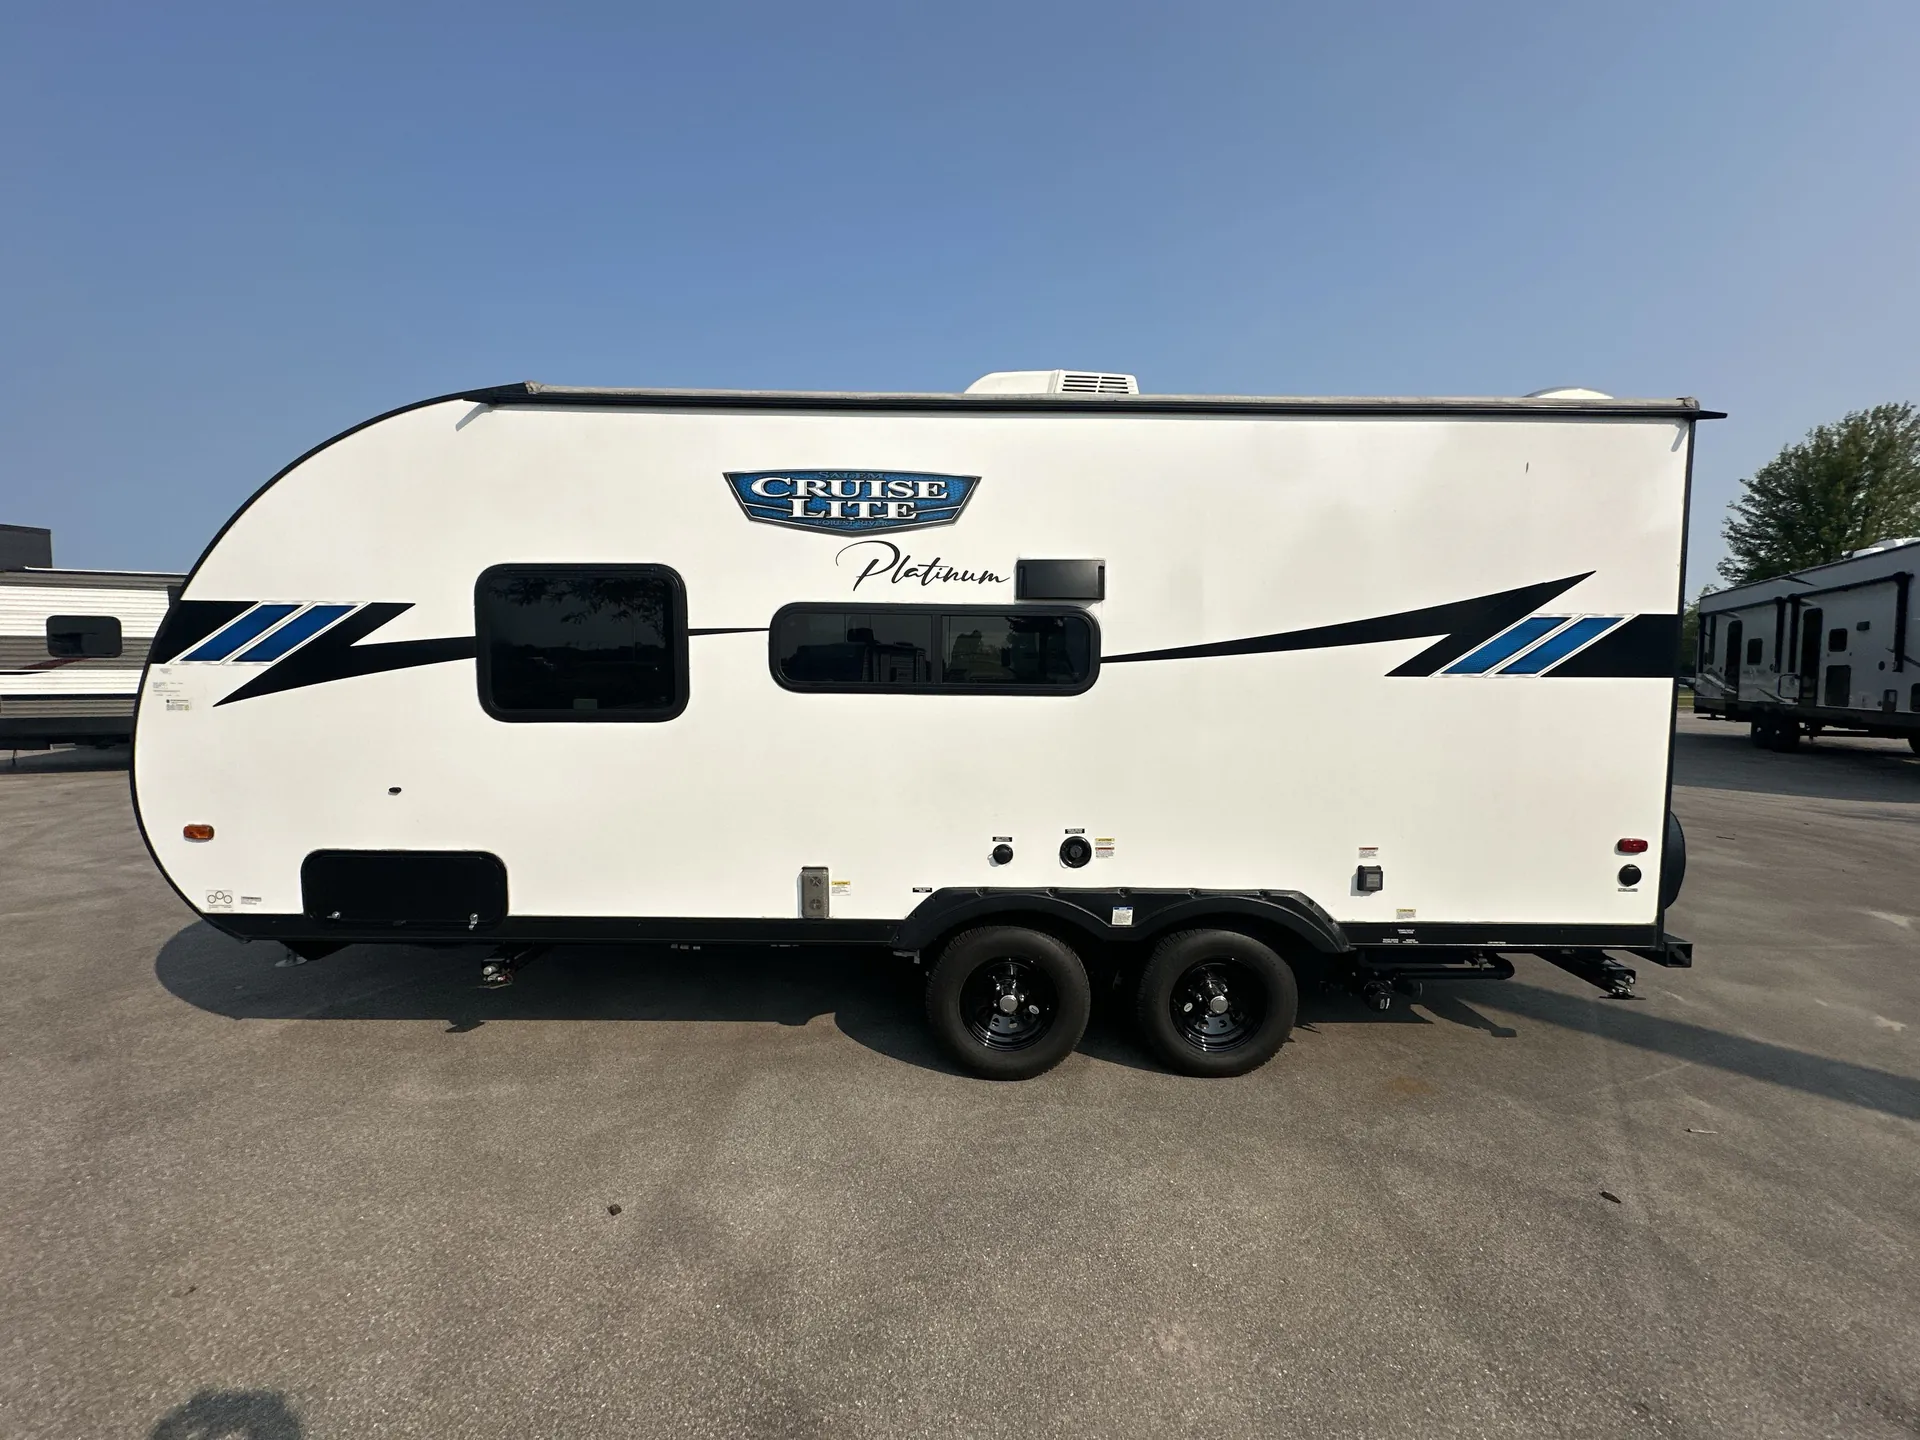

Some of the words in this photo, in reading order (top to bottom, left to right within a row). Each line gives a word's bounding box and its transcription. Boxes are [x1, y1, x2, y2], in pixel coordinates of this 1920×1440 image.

[818, 471, 886, 480] SALEM
[750, 477, 949, 499] CRUISE
[787, 498, 917, 520] LITE
[836, 540, 1010, 591] Platinum
